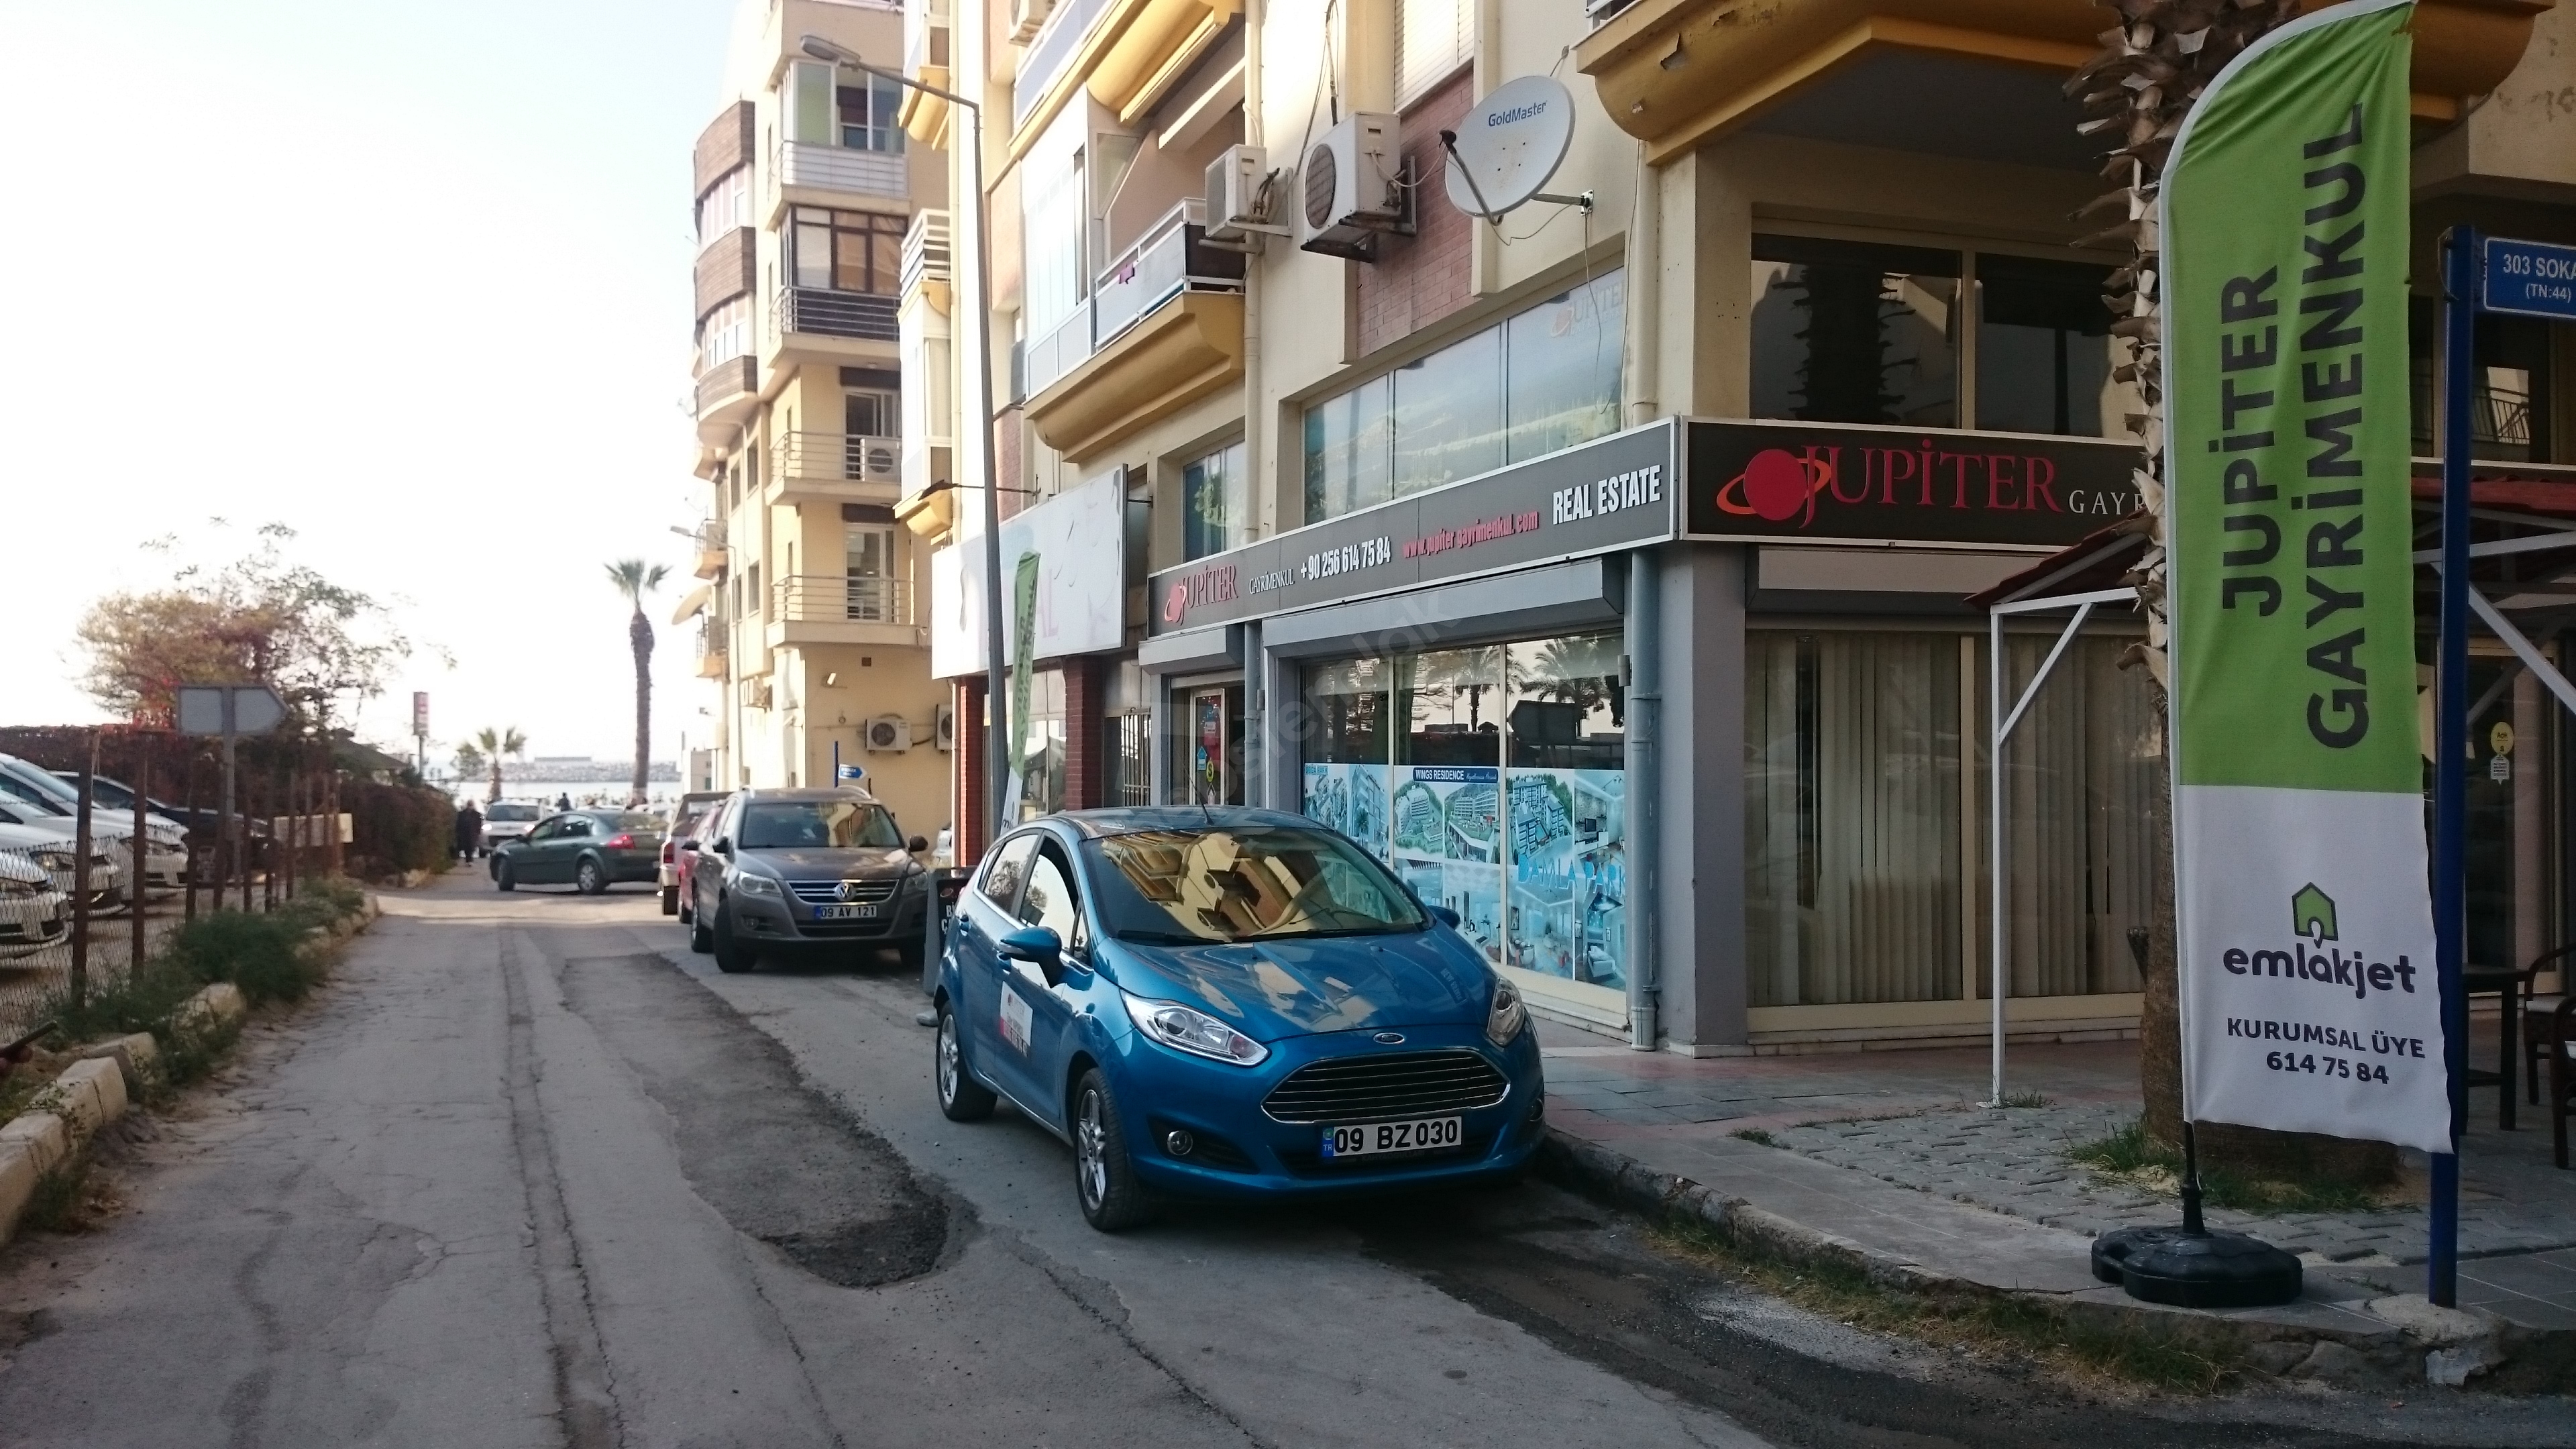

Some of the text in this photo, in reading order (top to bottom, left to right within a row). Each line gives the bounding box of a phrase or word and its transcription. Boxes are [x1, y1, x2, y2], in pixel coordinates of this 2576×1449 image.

[1488, 101, 1546, 127] GoldMaster
[2503, 254, 2530, 275] 303
[2208, 265, 2282, 618] JUPİTER
[1799, 439, 2065, 529] JUPİTER
[1249, 572, 1295, 594] GAYRİMENKUL
[1301, 553, 1321, 580] +90
[1322, 548, 1340, 578] 256
[1342, 544, 1360, 573] 614
[1361, 539, 1375, 568] 75
[1377, 536, 1391, 565] 84
[1553, 483, 1593, 525] REAL
[1598, 464, 1662, 515] ESTATE
[1415, 769, 1433, 780] WINGS
[1434, 769, 1464, 780] RESIDENCE
[1517, 854, 1576, 890] DAMLA
[821, 906, 874, 917] 09 AV 121
[2223, 943, 2416, 1000] emlakjet
[2227, 1018, 2426, 1059] KURUMSAL ÜYE
[2266, 1051, 2390, 1085] 614 75 84
[1323, 1119, 1458, 1153] TR 09 BZ 030
